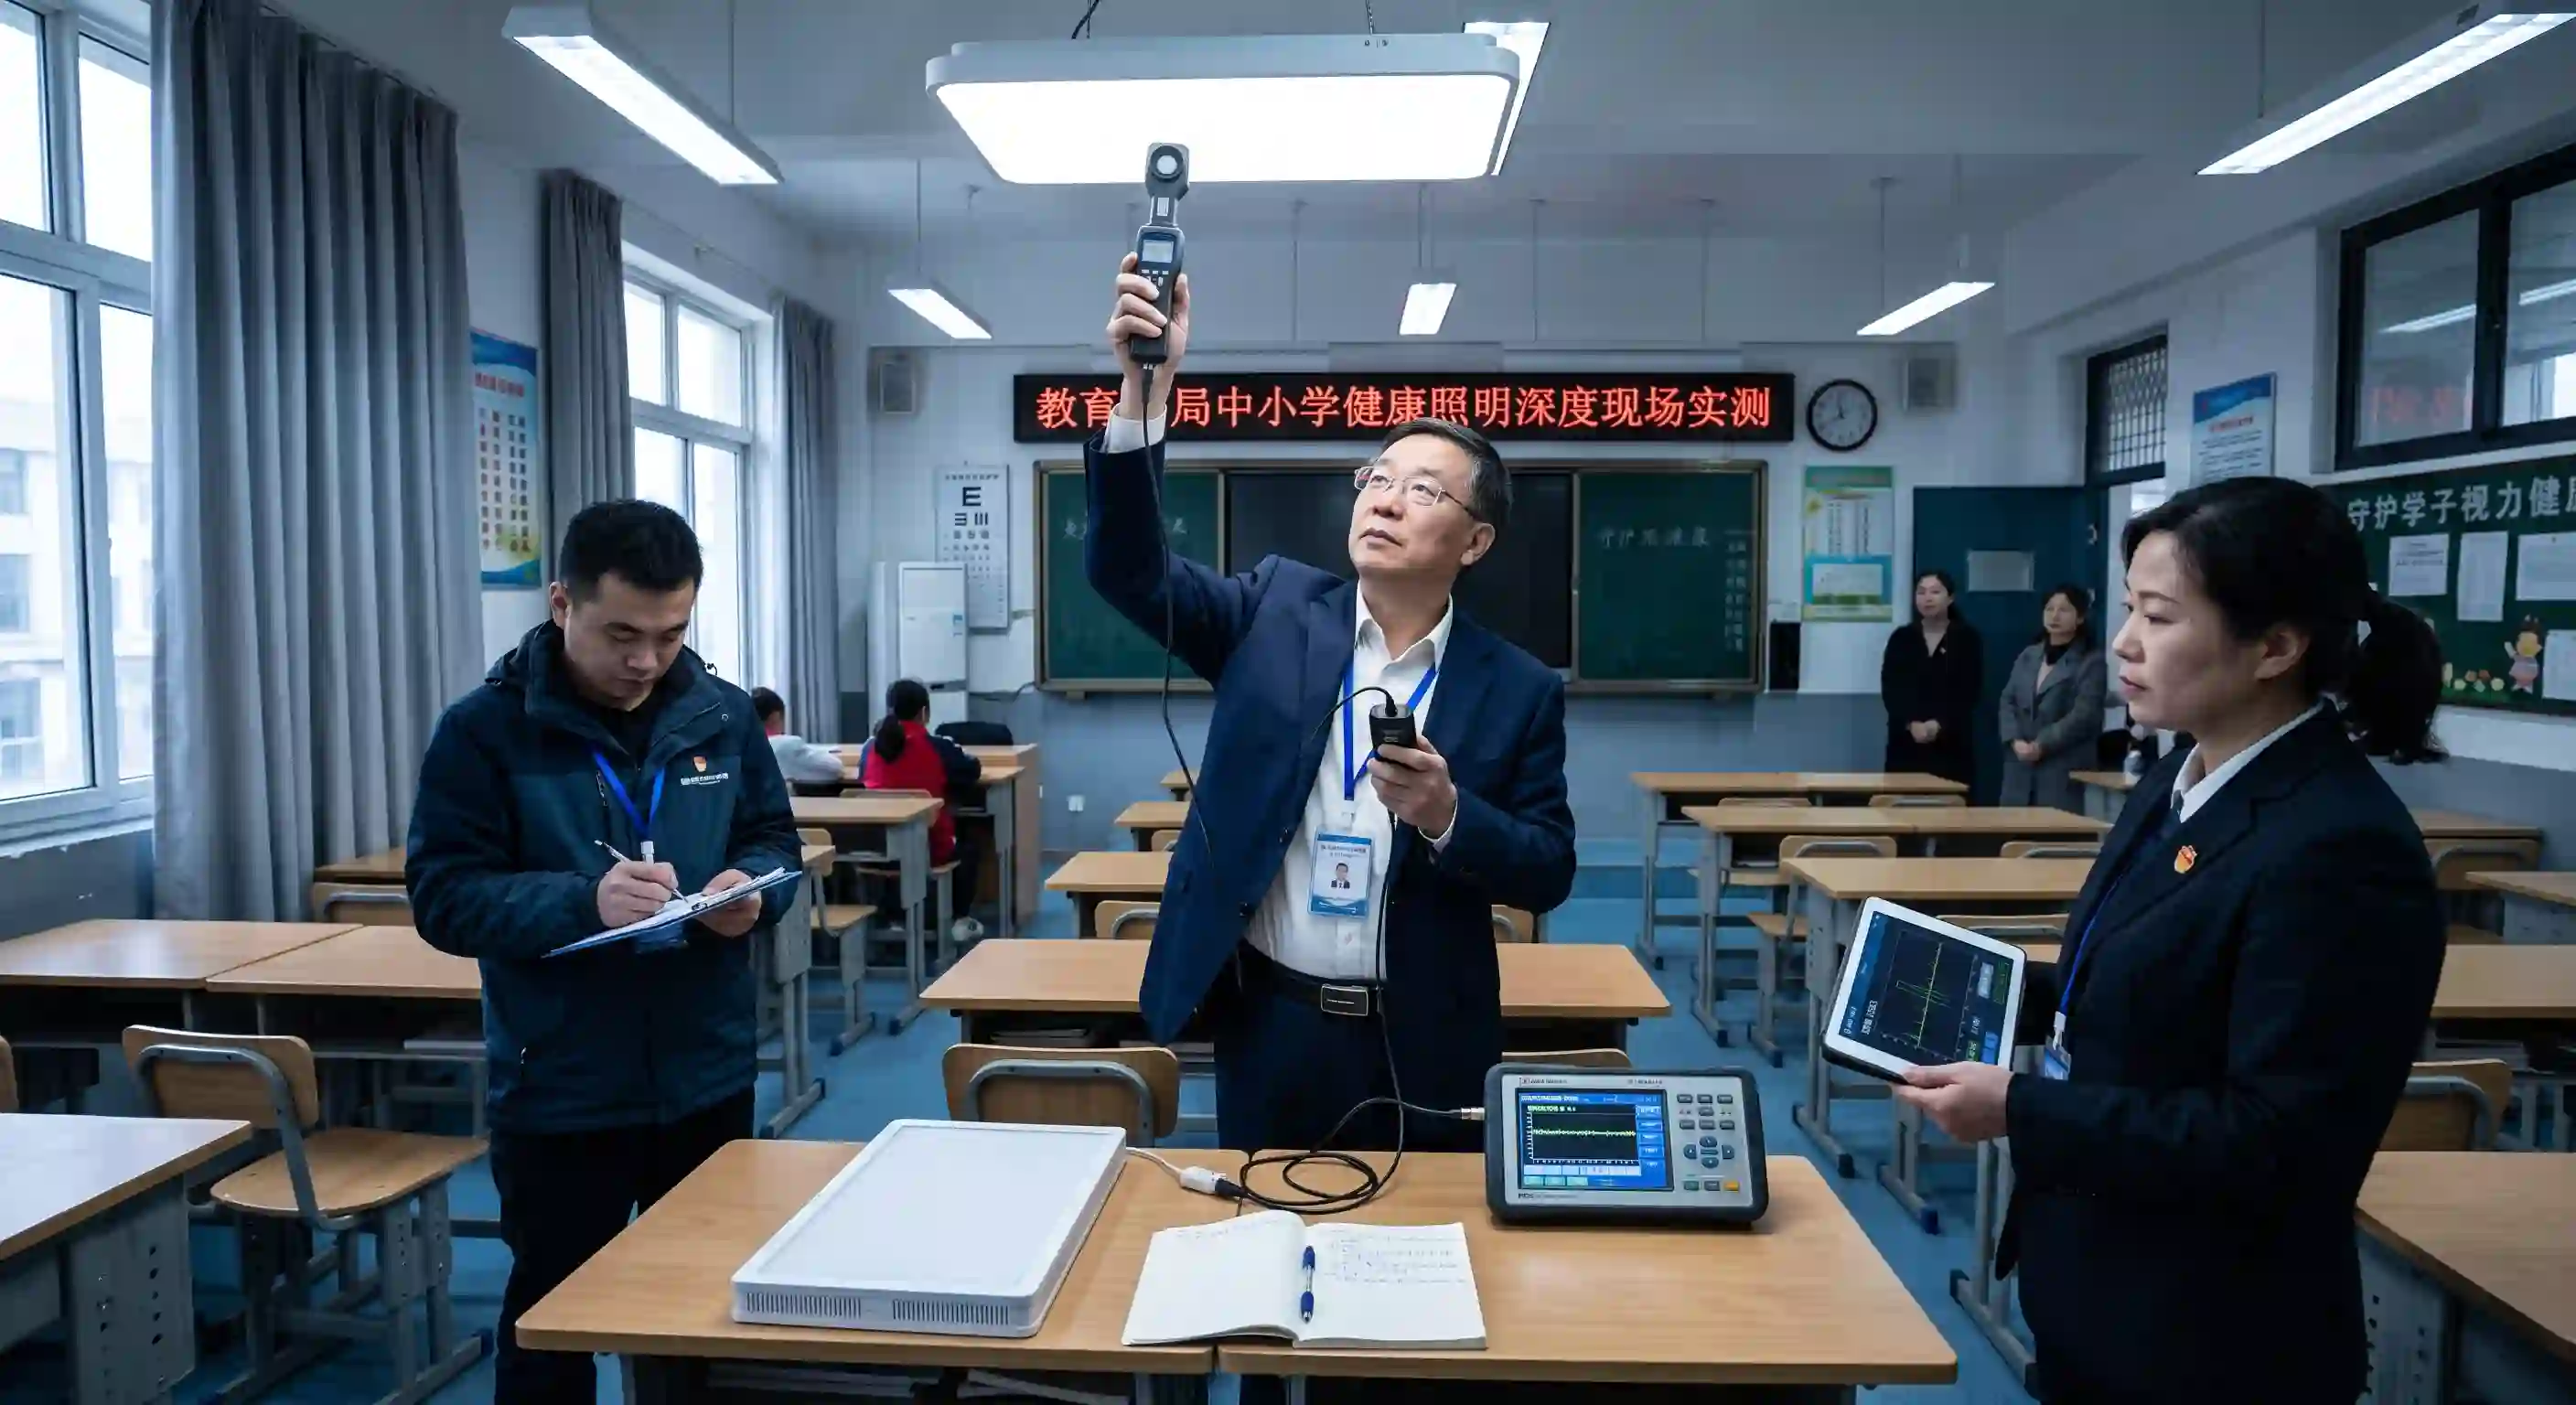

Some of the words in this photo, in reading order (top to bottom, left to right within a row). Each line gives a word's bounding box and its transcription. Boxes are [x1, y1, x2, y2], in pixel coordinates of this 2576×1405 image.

[1036, 385, 1771, 429] 教育局中小学健康照明深度现场实测
